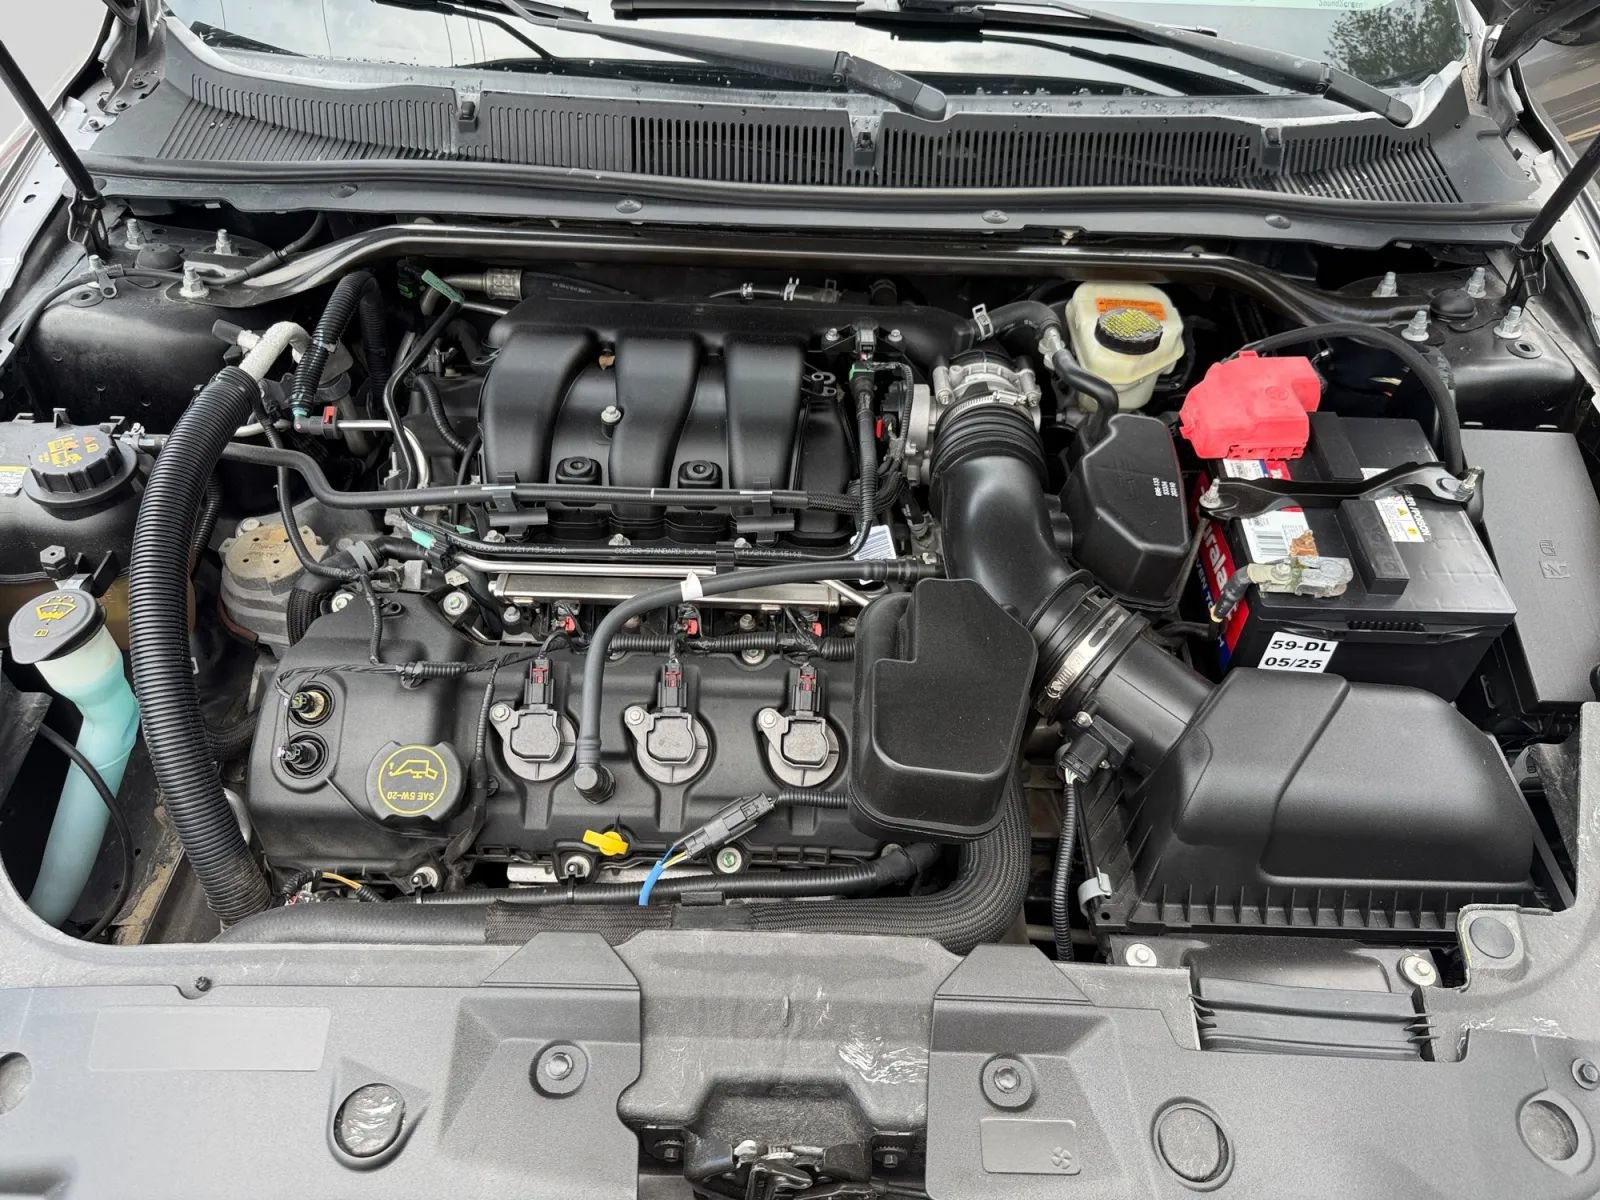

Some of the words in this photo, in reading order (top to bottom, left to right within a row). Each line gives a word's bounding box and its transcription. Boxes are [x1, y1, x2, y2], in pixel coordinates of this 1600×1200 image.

[1270, 640, 1331, 652] 59-DL
[1264, 657, 1323, 669] 05/25
[387, 792, 415, 801] 5W-20
[417, 792, 435, 801] SAE
